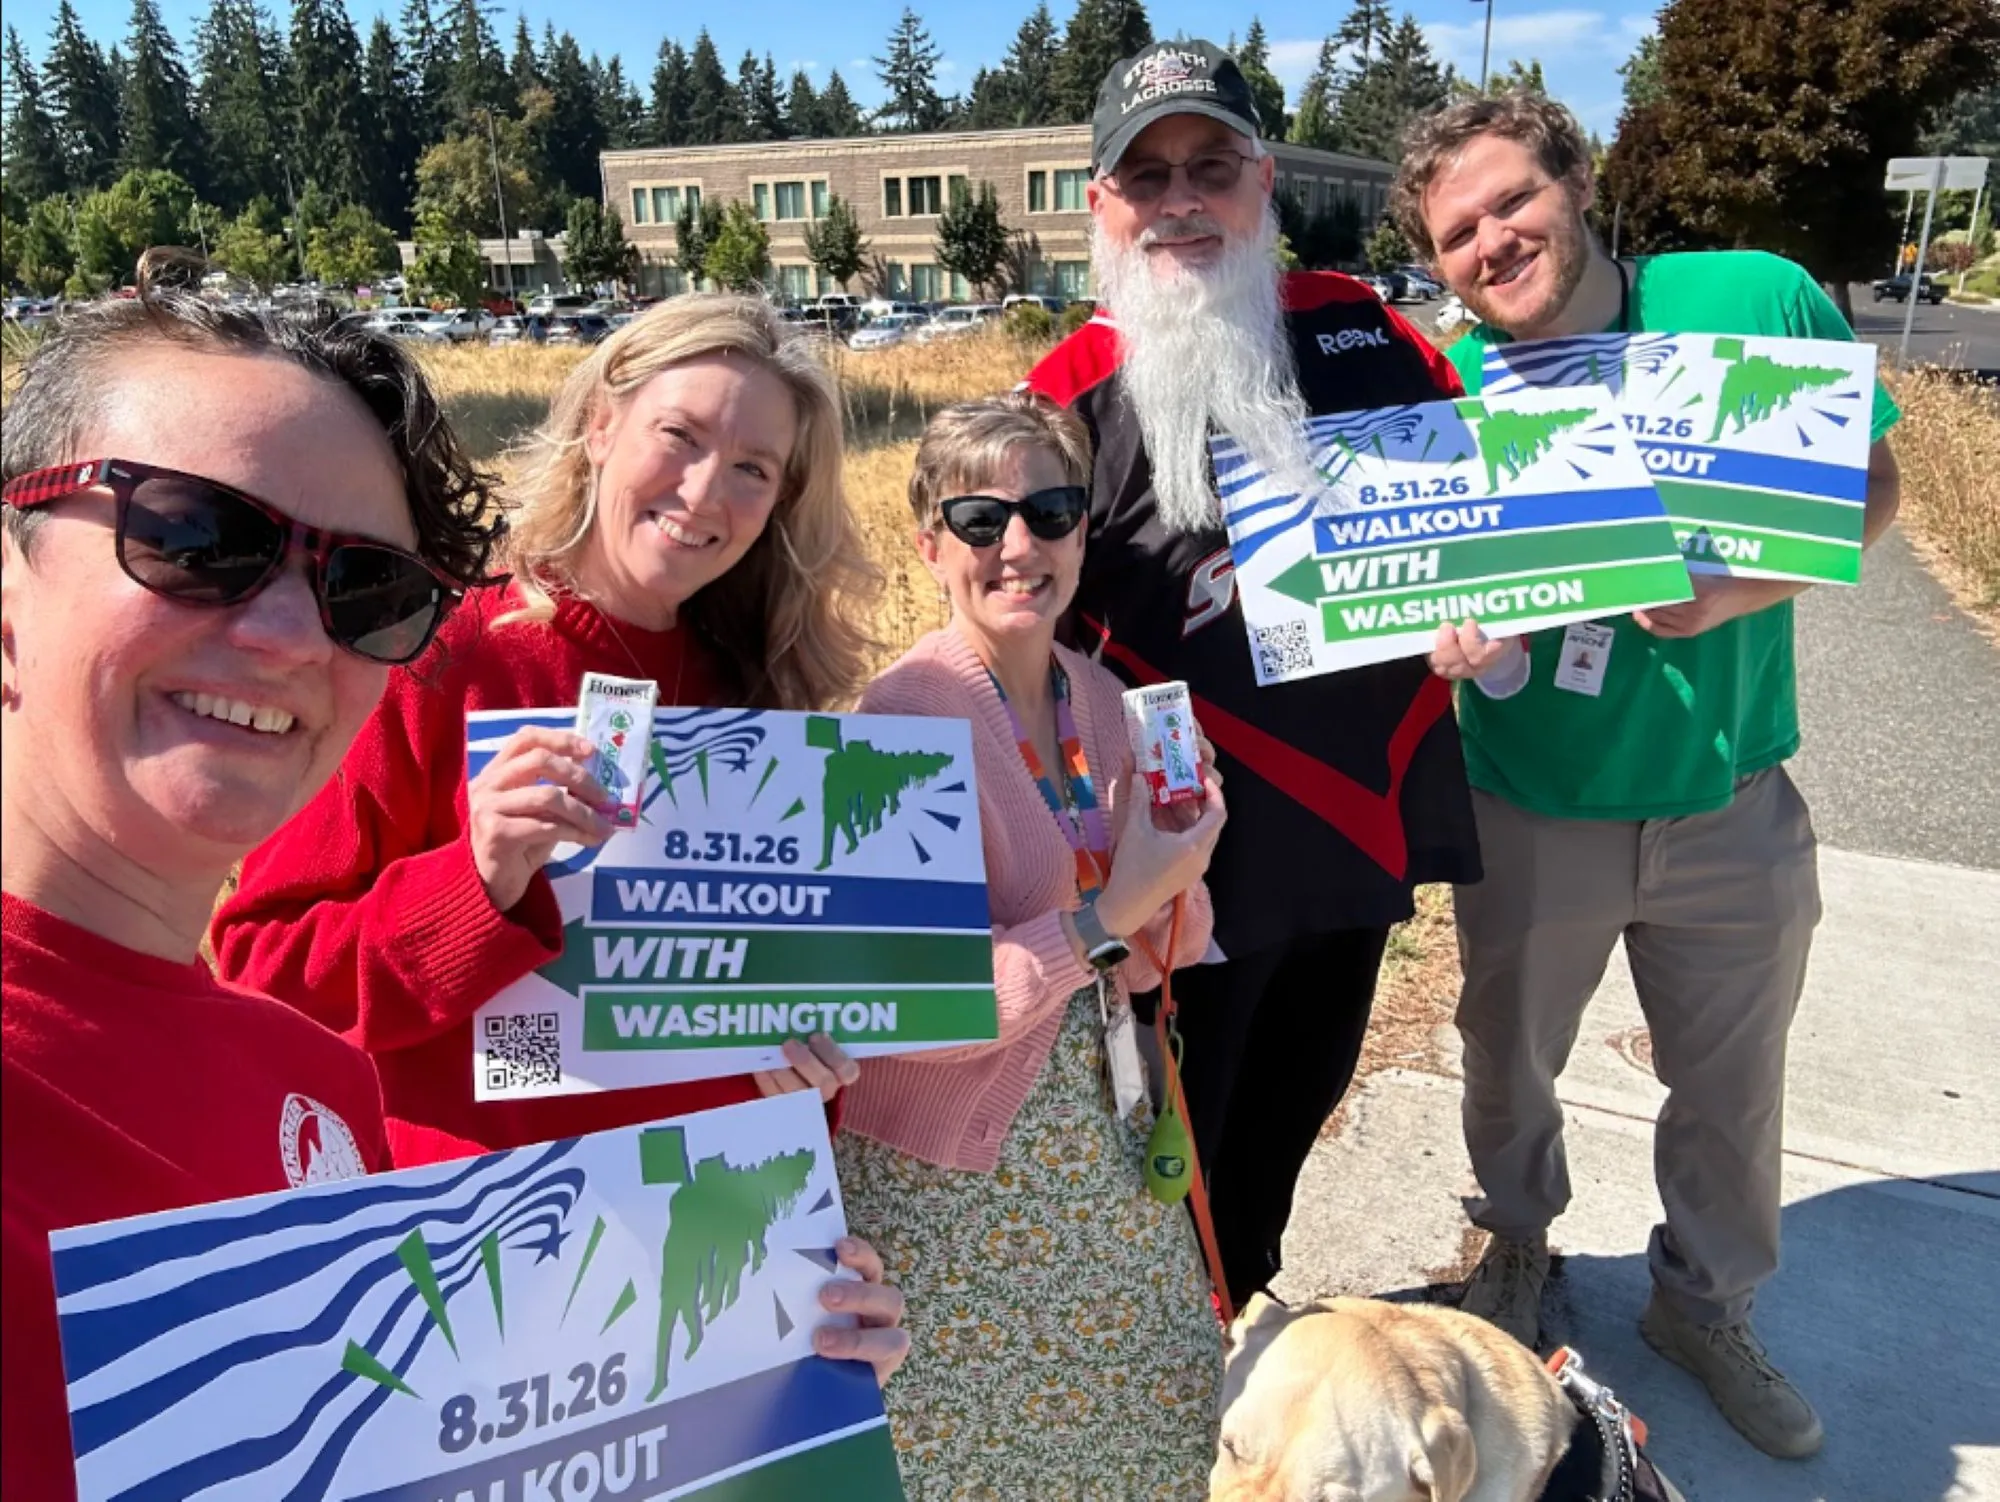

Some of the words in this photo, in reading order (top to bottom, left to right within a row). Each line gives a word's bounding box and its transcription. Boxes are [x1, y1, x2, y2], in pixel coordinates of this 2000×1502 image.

[1120, 79, 1217, 114] LACROSSE
[1639, 447, 1717, 476] OUT
[1359, 476, 1470, 505] 8.31.26
[1329, 504, 1503, 545] WALKOUT
[1319, 549, 1440, 593] WITH
[1340, 579, 1584, 632] WASHINGTON
[664, 829, 799, 865] 8.31.26
[616, 879, 831, 917] WALKOUT
[593, 936, 749, 979] WITH
[611, 1001, 898, 1038] WASHINGTON
[438, 1352, 627, 1453] 8.31.26
